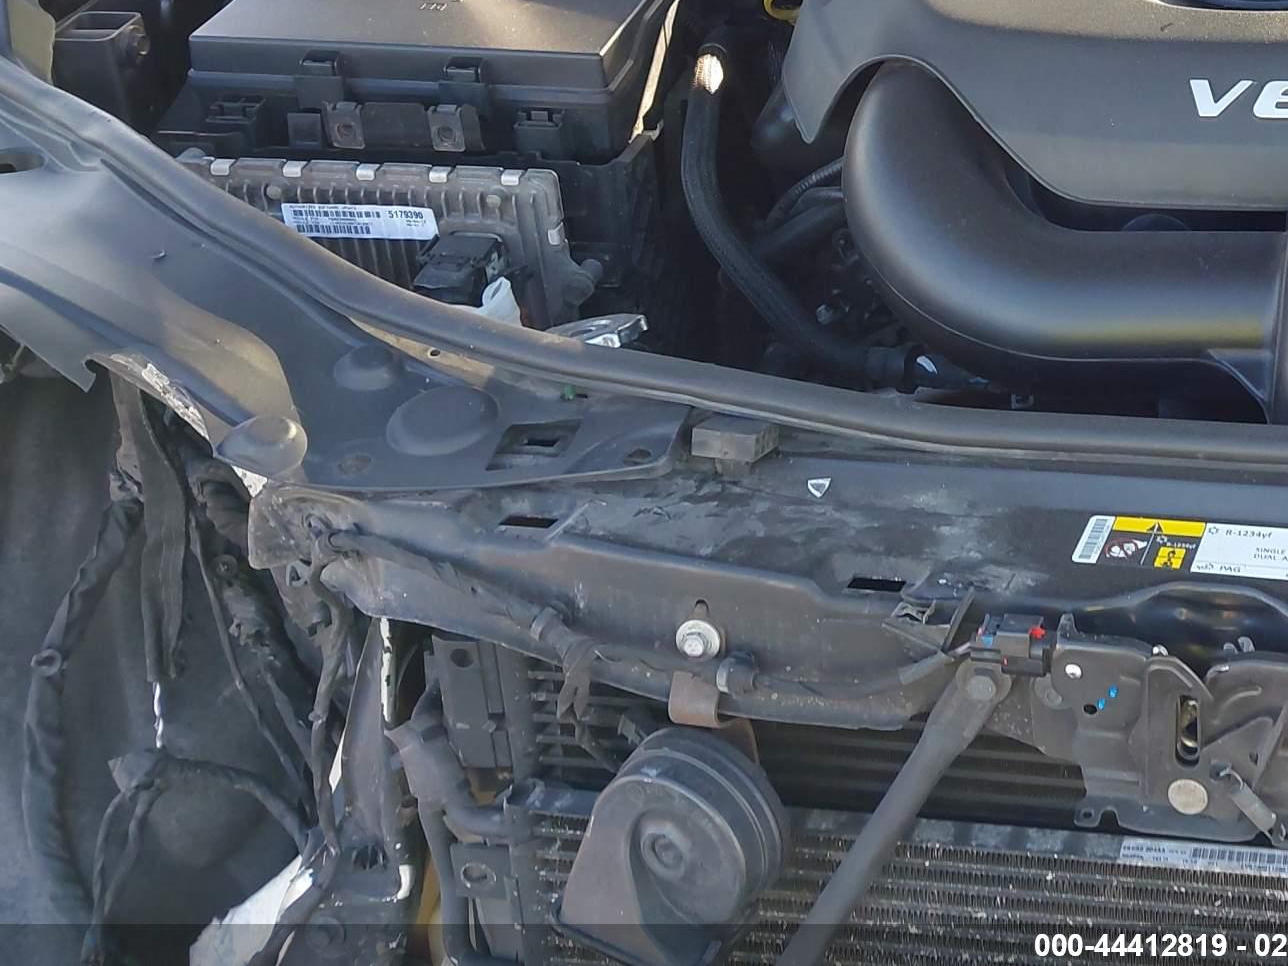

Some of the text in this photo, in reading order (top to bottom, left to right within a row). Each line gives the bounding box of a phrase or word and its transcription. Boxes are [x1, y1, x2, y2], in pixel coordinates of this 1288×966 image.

[388, 210, 424, 220] 5179390
[1225, 529, 1273, 540] R-1234yf
[1252, 553, 1278, 561] DUAL
